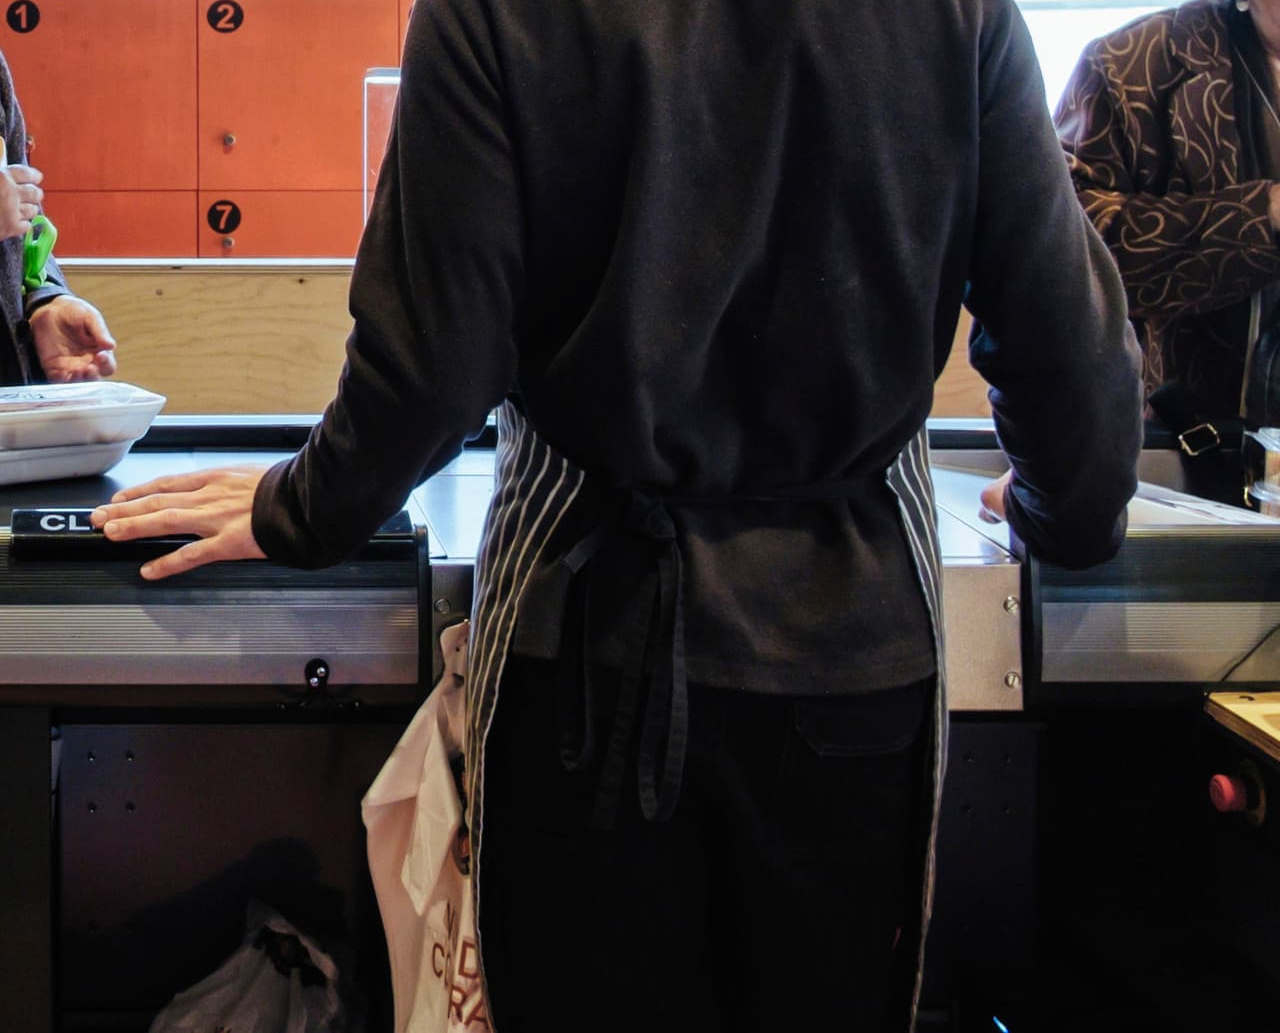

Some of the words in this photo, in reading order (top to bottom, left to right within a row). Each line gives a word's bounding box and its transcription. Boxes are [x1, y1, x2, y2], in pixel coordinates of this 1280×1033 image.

[15, 4, 28, 29] 1
[216, 3, 235, 31] 2
[215, 205, 232, 229] 7
[39, 514, 96, 532] CL
